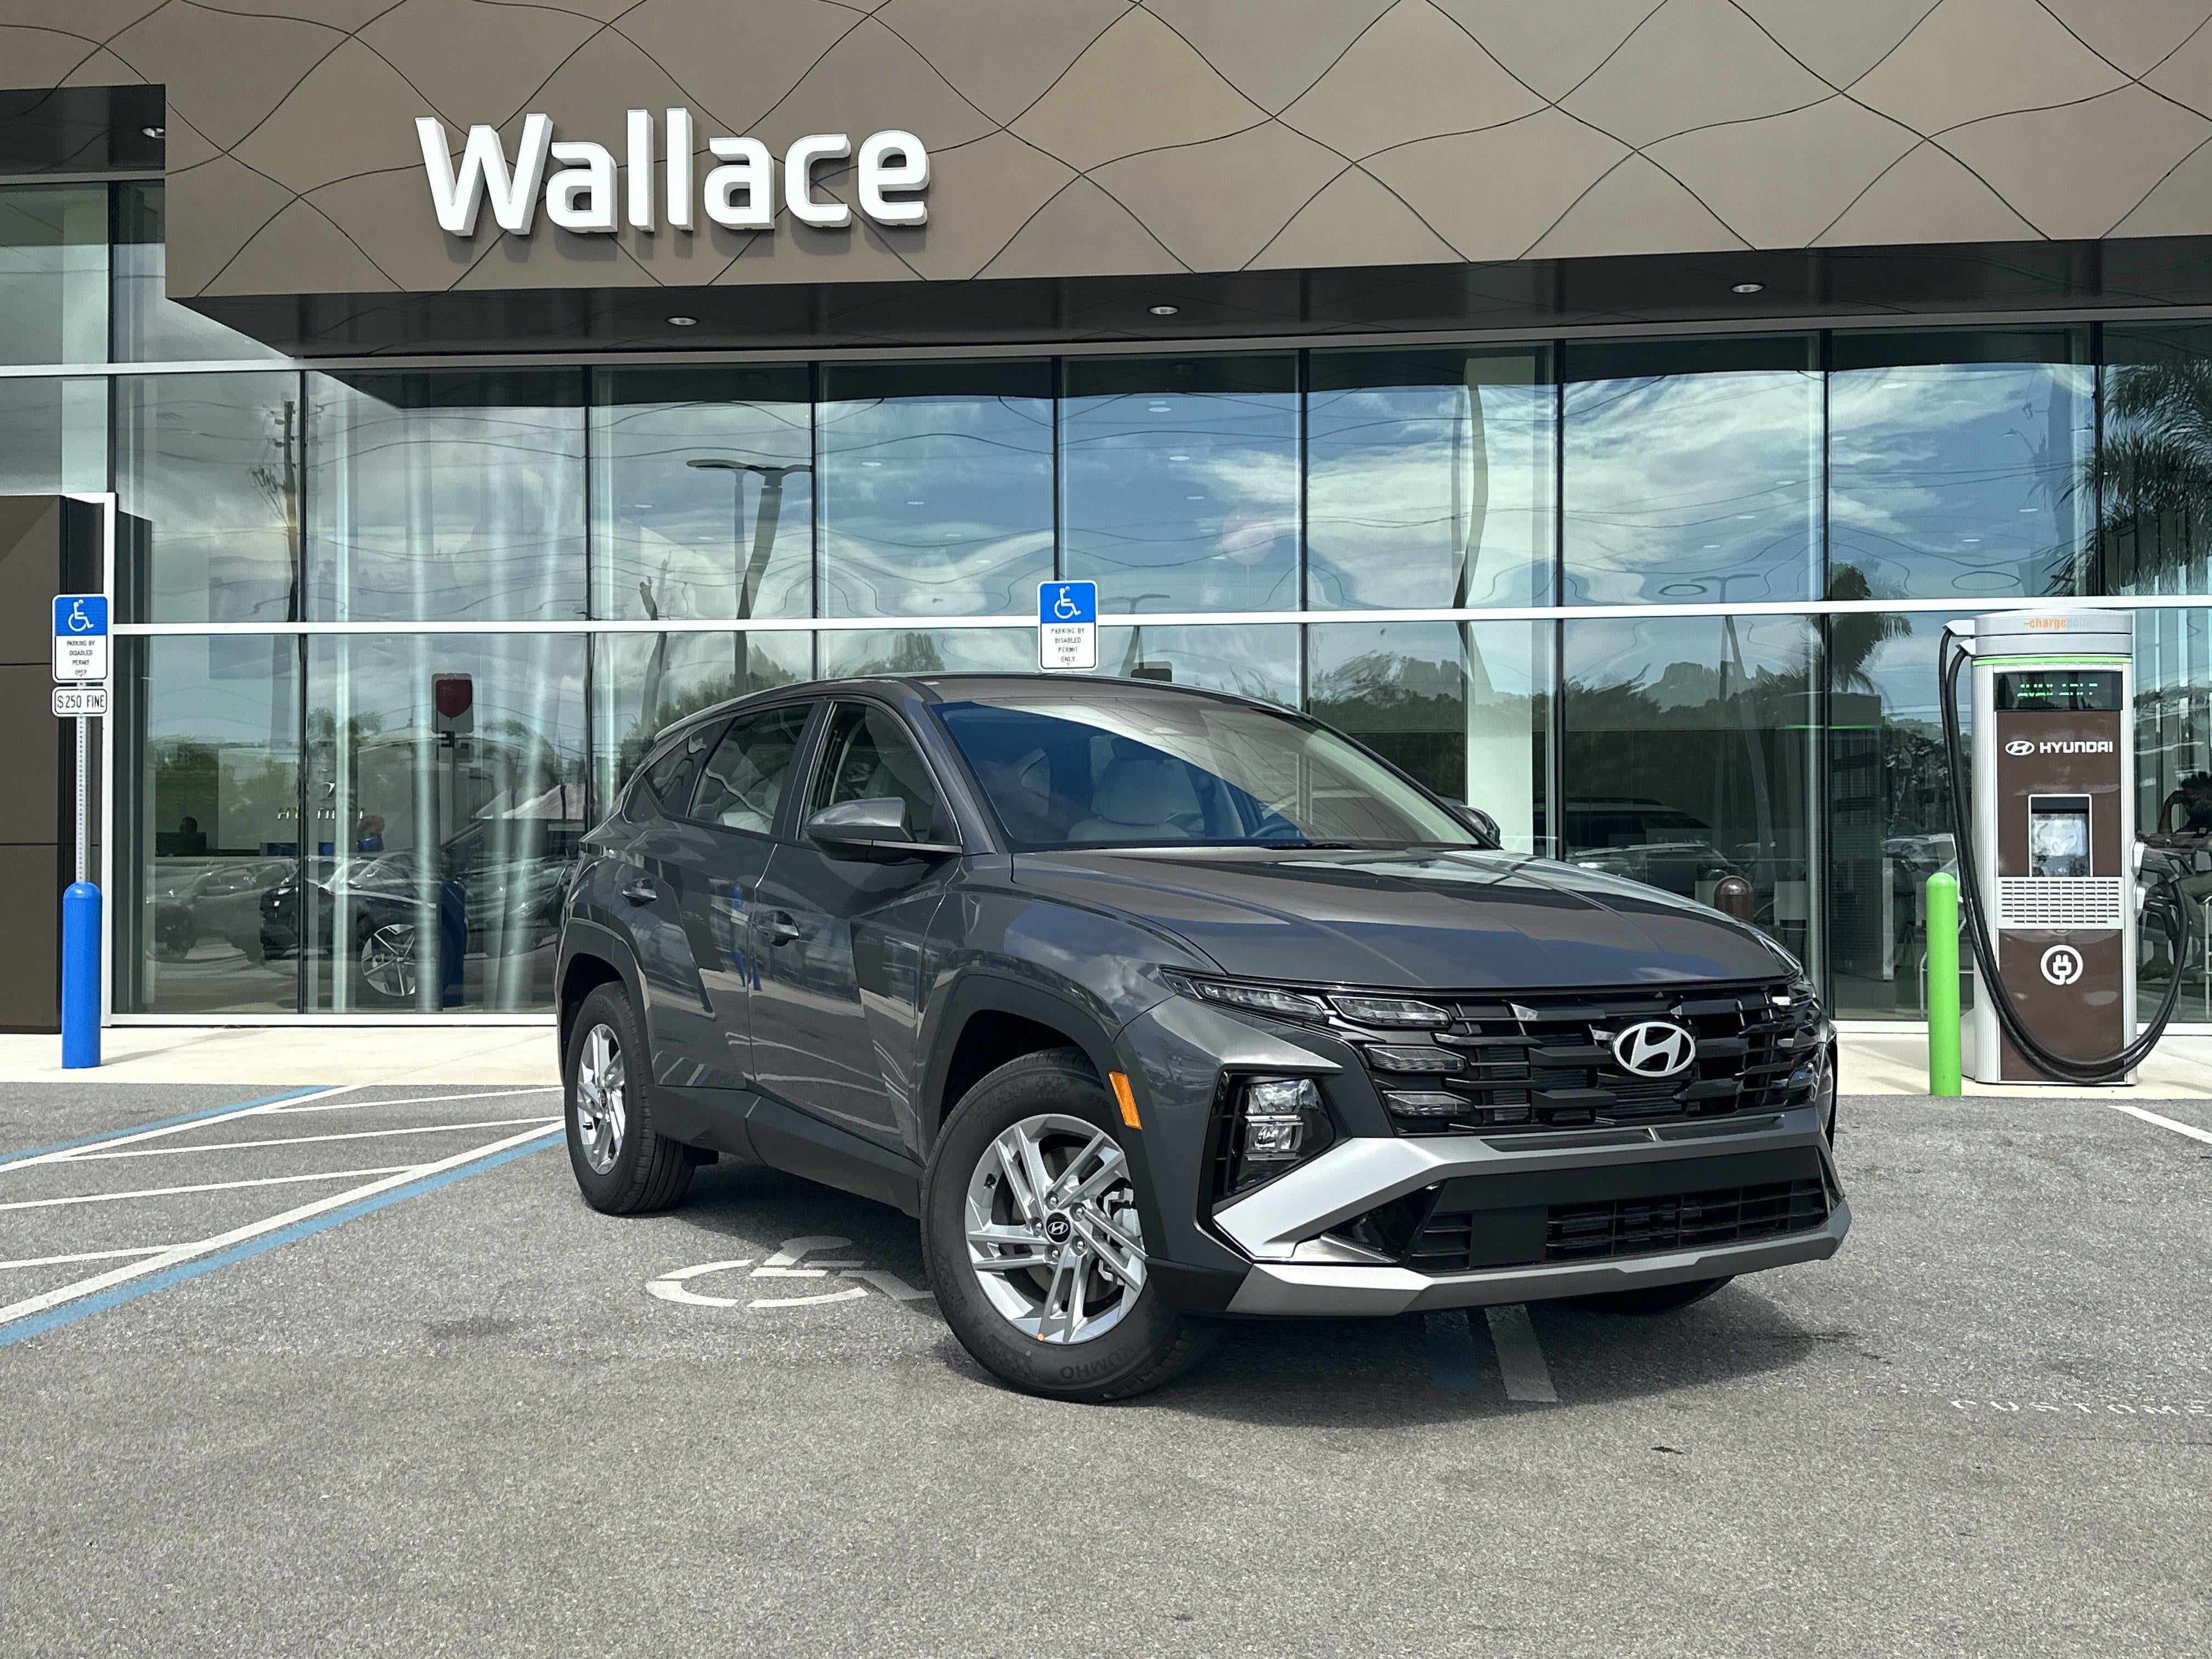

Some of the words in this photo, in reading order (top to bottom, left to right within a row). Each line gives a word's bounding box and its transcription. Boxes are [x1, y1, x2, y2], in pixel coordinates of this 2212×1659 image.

[415, 108, 930, 236] Wallace
[57, 695, 82, 708] $250
[87, 695, 104, 708] FINE
[2040, 741, 2113, 754] HYUNDAI
[1059, 1345, 1135, 1379] KUMHO
